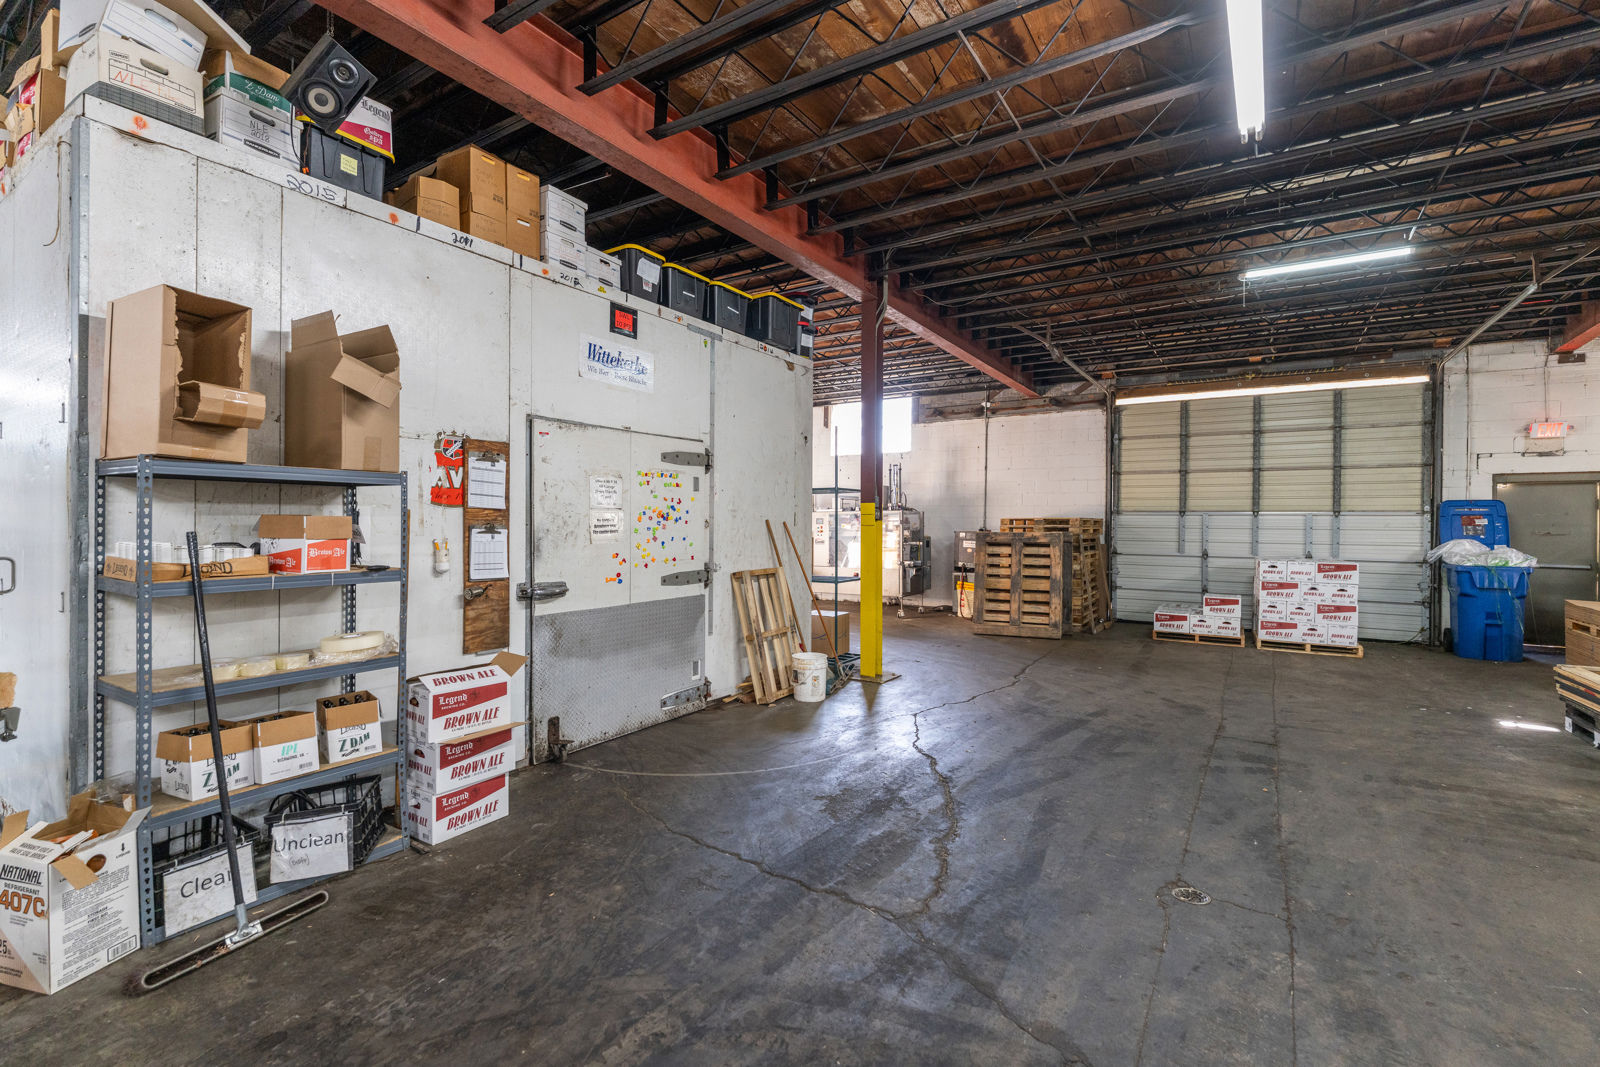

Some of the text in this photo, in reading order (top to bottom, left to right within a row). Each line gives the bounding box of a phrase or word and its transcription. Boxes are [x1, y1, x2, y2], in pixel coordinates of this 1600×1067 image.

[361, 99, 391, 122] Legend
[250, 121, 269, 134] NLE
[286, 174, 337, 200] 2015
[1537, 423, 1563, 437] EXIT
[308, 547, 345, 558] Brown Ale
[182, 562, 233, 578] LGEND
[432, 668, 498, 687] BROWN ALE
[438, 692, 468, 705] Legend
[443, 710, 481, 731] BROWN
[482, 706, 500, 721] ALE
[338, 738, 350, 753] Z
[350, 732, 371, 749] DAM
[444, 742, 473, 755] Legend
[201, 764, 240, 788] Z AM
[450, 755, 487, 780] BROWN
[487, 751, 505, 767] ALE
[441, 791, 469, 807] Legend
[446, 806, 481, 831] BROWN
[482, 799, 499, 816] ALE
[273, 831, 344, 853] Unclean
[0, 863, 43, 885] NATIONAL
[4, 882, 40, 896] REFRIGERANT
[0, 889, 46, 918] 407C
